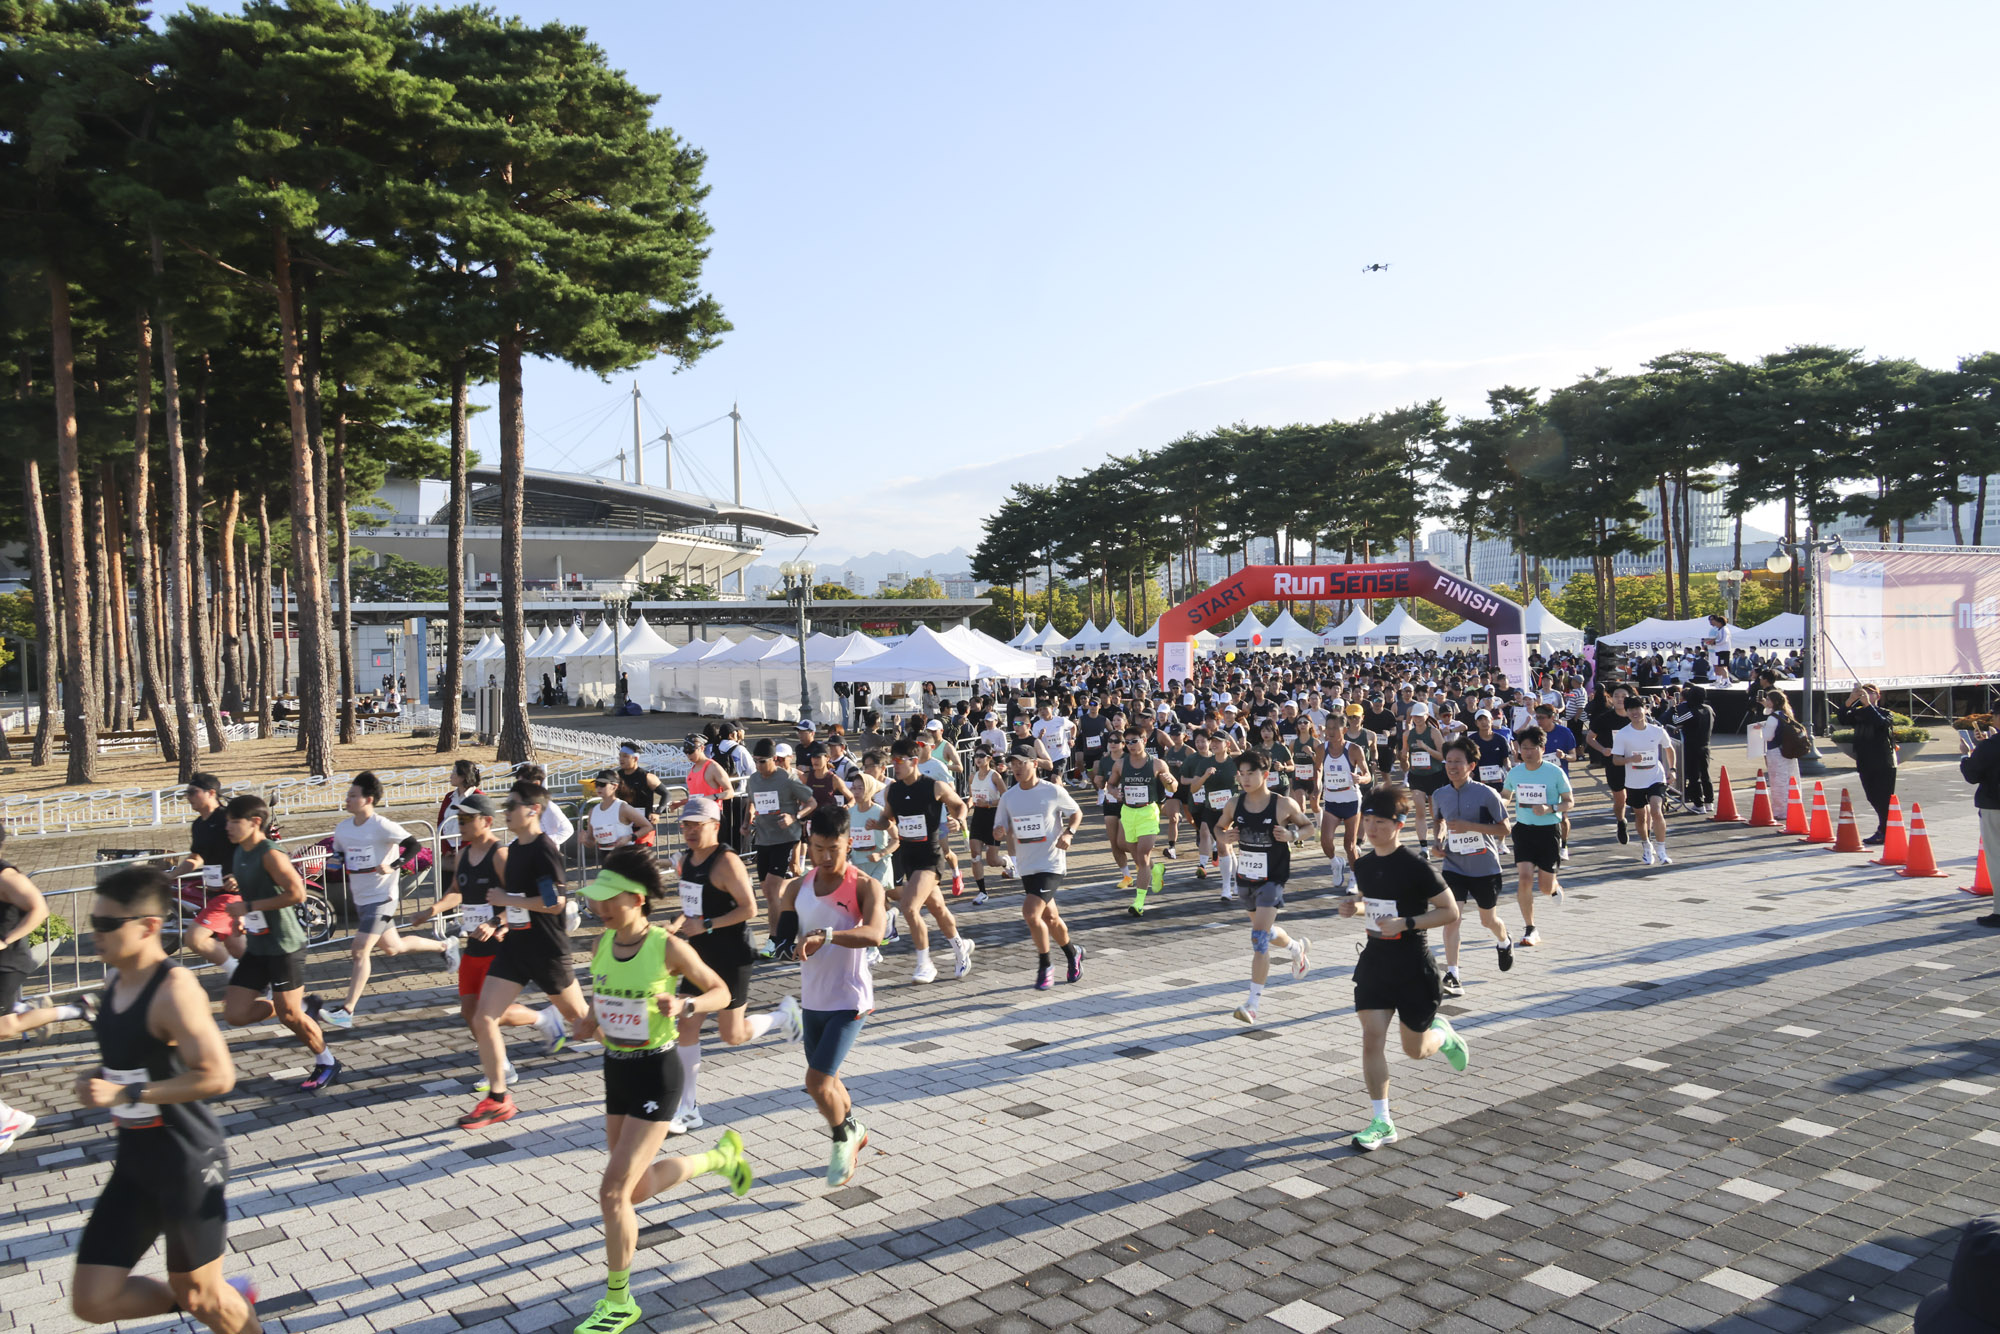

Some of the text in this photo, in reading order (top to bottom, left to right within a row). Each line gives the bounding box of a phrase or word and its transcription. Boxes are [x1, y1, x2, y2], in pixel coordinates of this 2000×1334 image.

[1433, 575, 1500, 617] FINISH
[1187, 581, 1247, 624] START
[1651, 641, 1682, 649] ROOM
[1759, 638, 1779, 647] MC
[1459, 836, 1478, 844] 1056
[609, 1012, 642, 1026] 2176
